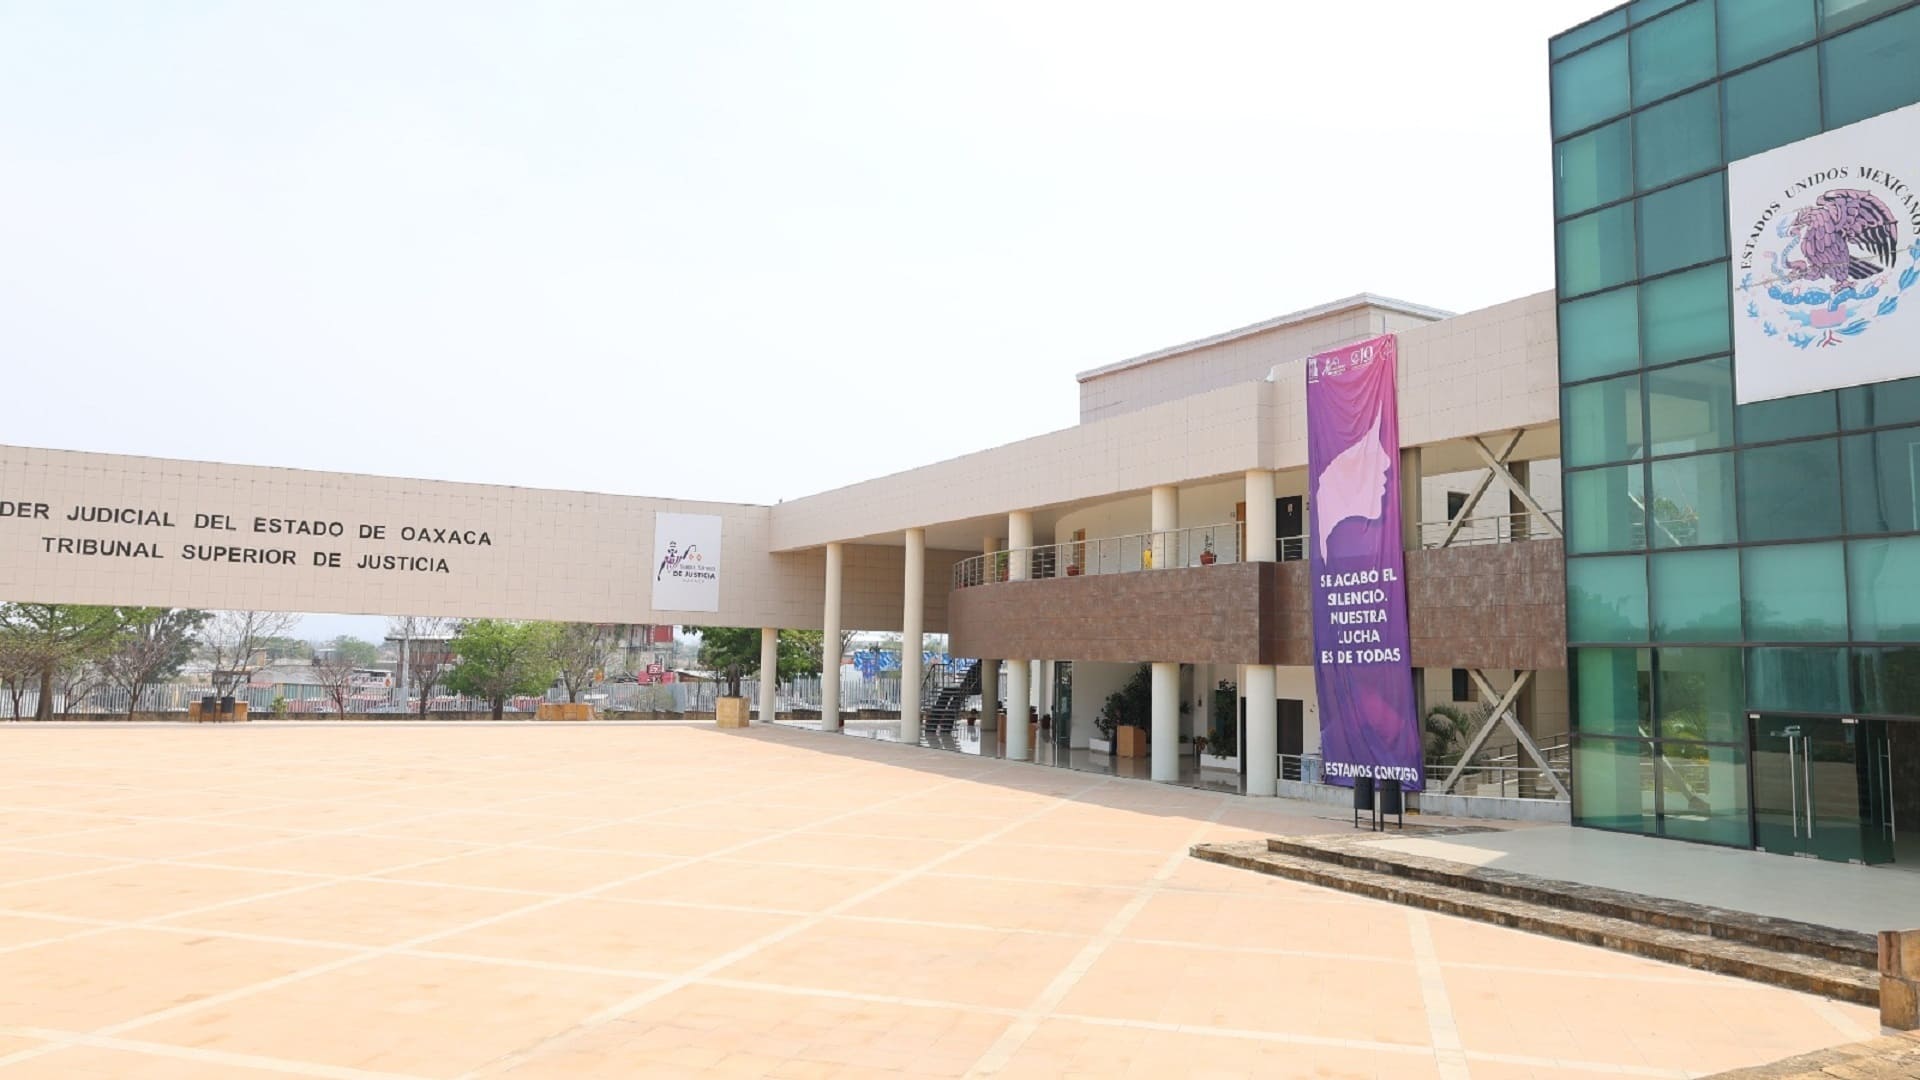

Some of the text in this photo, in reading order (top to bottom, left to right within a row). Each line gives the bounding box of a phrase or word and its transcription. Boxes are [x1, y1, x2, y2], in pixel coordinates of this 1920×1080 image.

[1740, 166, 1920, 269] ESTADOS UNIDOS MEXICANOS
[66, 505, 176, 527] JUDICIAL
[194, 513, 237, 531] DEL
[253, 516, 344, 538] ESTADO
[359, 524, 386, 540] DE
[400, 526, 492, 546] OAXACA
[41, 536, 450, 574] TRIBUNAL SUPERIOR DE JUSTICIA
[684, 571, 716, 579] JUSTICIA
[1320, 566, 1398, 588] SE ACABÓ EL
[1327, 588, 1389, 606] SILENCIO.
[1330, 608, 1388, 625] NUESTRA
[1321, 647, 1401, 664] ES DE TODAS
[1325, 762, 1419, 782] ESTAMOS CONTIGO
